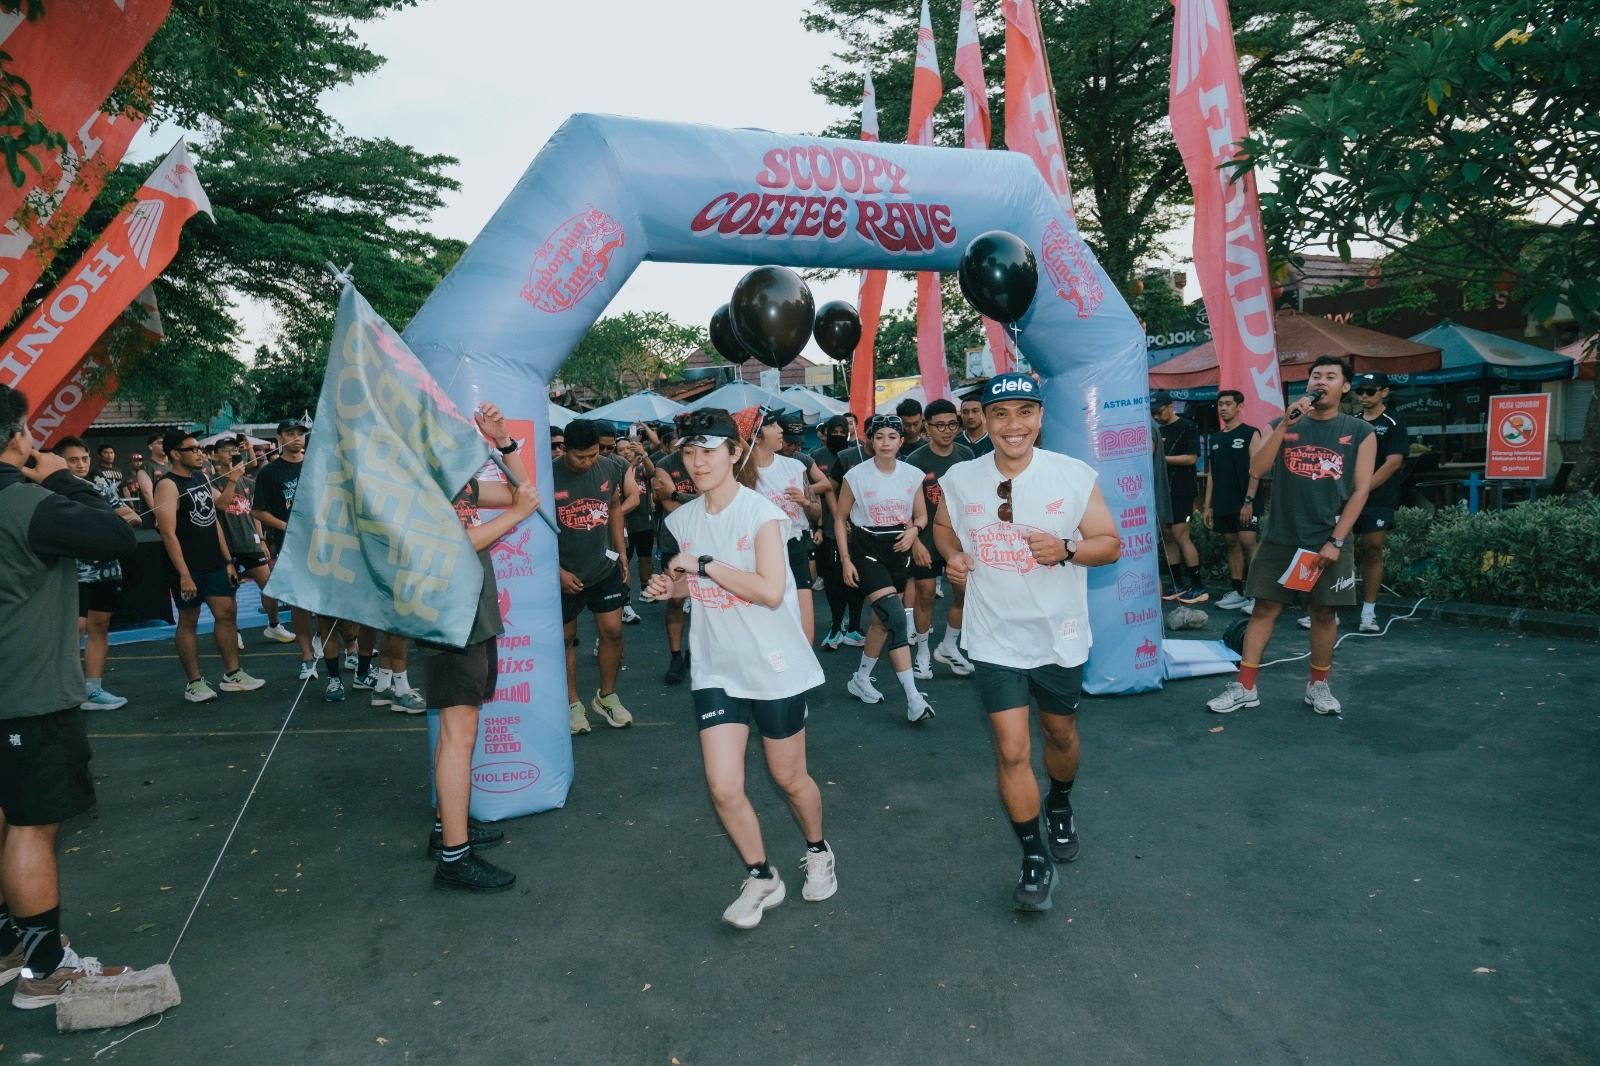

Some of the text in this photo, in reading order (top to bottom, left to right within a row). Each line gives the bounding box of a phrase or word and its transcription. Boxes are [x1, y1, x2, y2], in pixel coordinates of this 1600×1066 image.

[756, 145, 909, 195] SCOOPY
[690, 191, 959, 254] COFFEE RAVE
[1044, 238, 1080, 288] Time
[546, 251, 595, 306] Time
[1147, 330, 1196, 347] POJOK
[991, 378, 1032, 395] ciele
[1104, 398, 1131, 409] ASTRA
[1290, 457, 1320, 472] Time
[566, 514, 593, 525] Time
[979, 543, 1026, 562] Time
[484, 716, 521, 726] SHOES
[484, 726, 508, 734] AND
[484, 734, 515, 742] CARE
[485, 743, 520, 754] BALI
[473, 770, 535, 782] VIOLENCE
